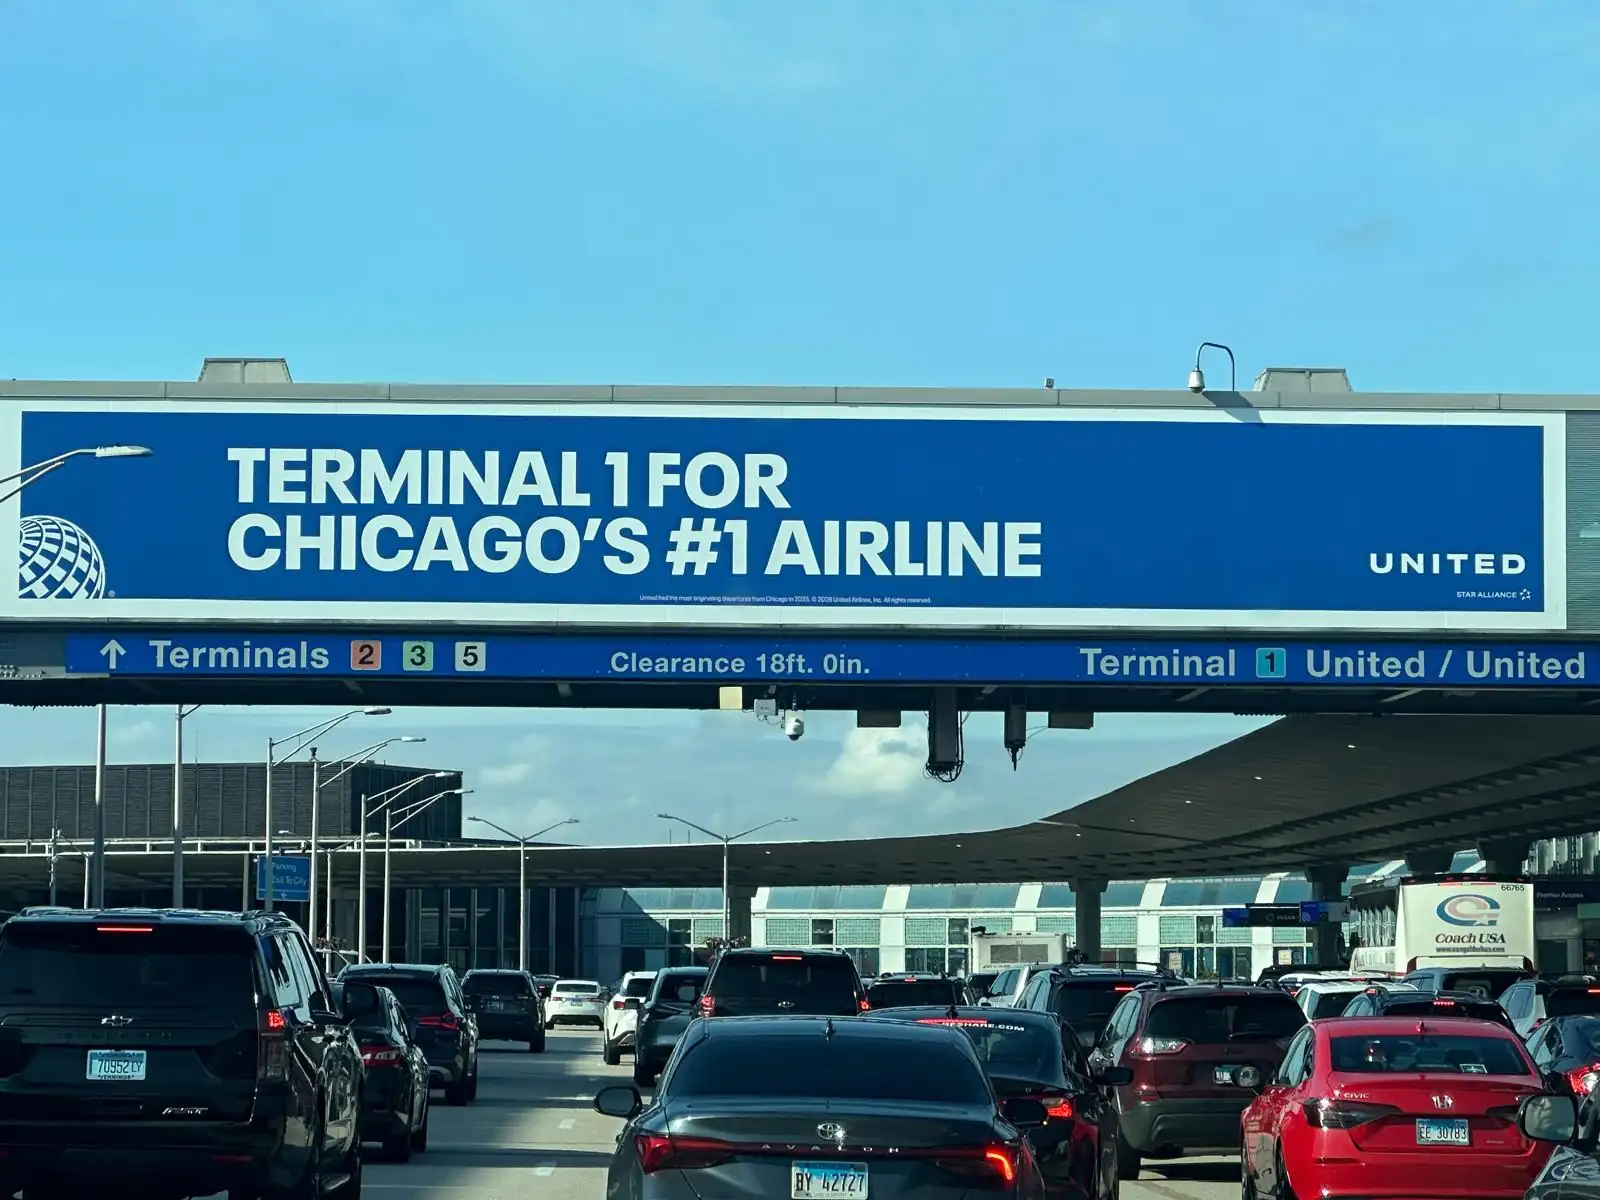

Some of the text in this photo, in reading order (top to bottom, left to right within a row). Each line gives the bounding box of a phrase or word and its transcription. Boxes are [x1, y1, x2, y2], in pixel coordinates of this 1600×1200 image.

[227, 447, 791, 510] TERMINAL 1 FOR
[227, 513, 1042, 578] CHICAGO'S #1 AIRLINE
[1370, 552, 1526, 575] UNITED
[1477, 591, 1517, 599] ALLIANCE
[148, 640, 479, 669] Terminals 2 3 5
[610, 651, 870, 675] Clearance 18ft. 0in.
[1079, 647, 1586, 680] Terminal 1 United / United
[1500, 883, 1525, 892] 66765
[1435, 932, 1507, 944] Coach USA
[795, 1172, 865, 1192] BY 42727
